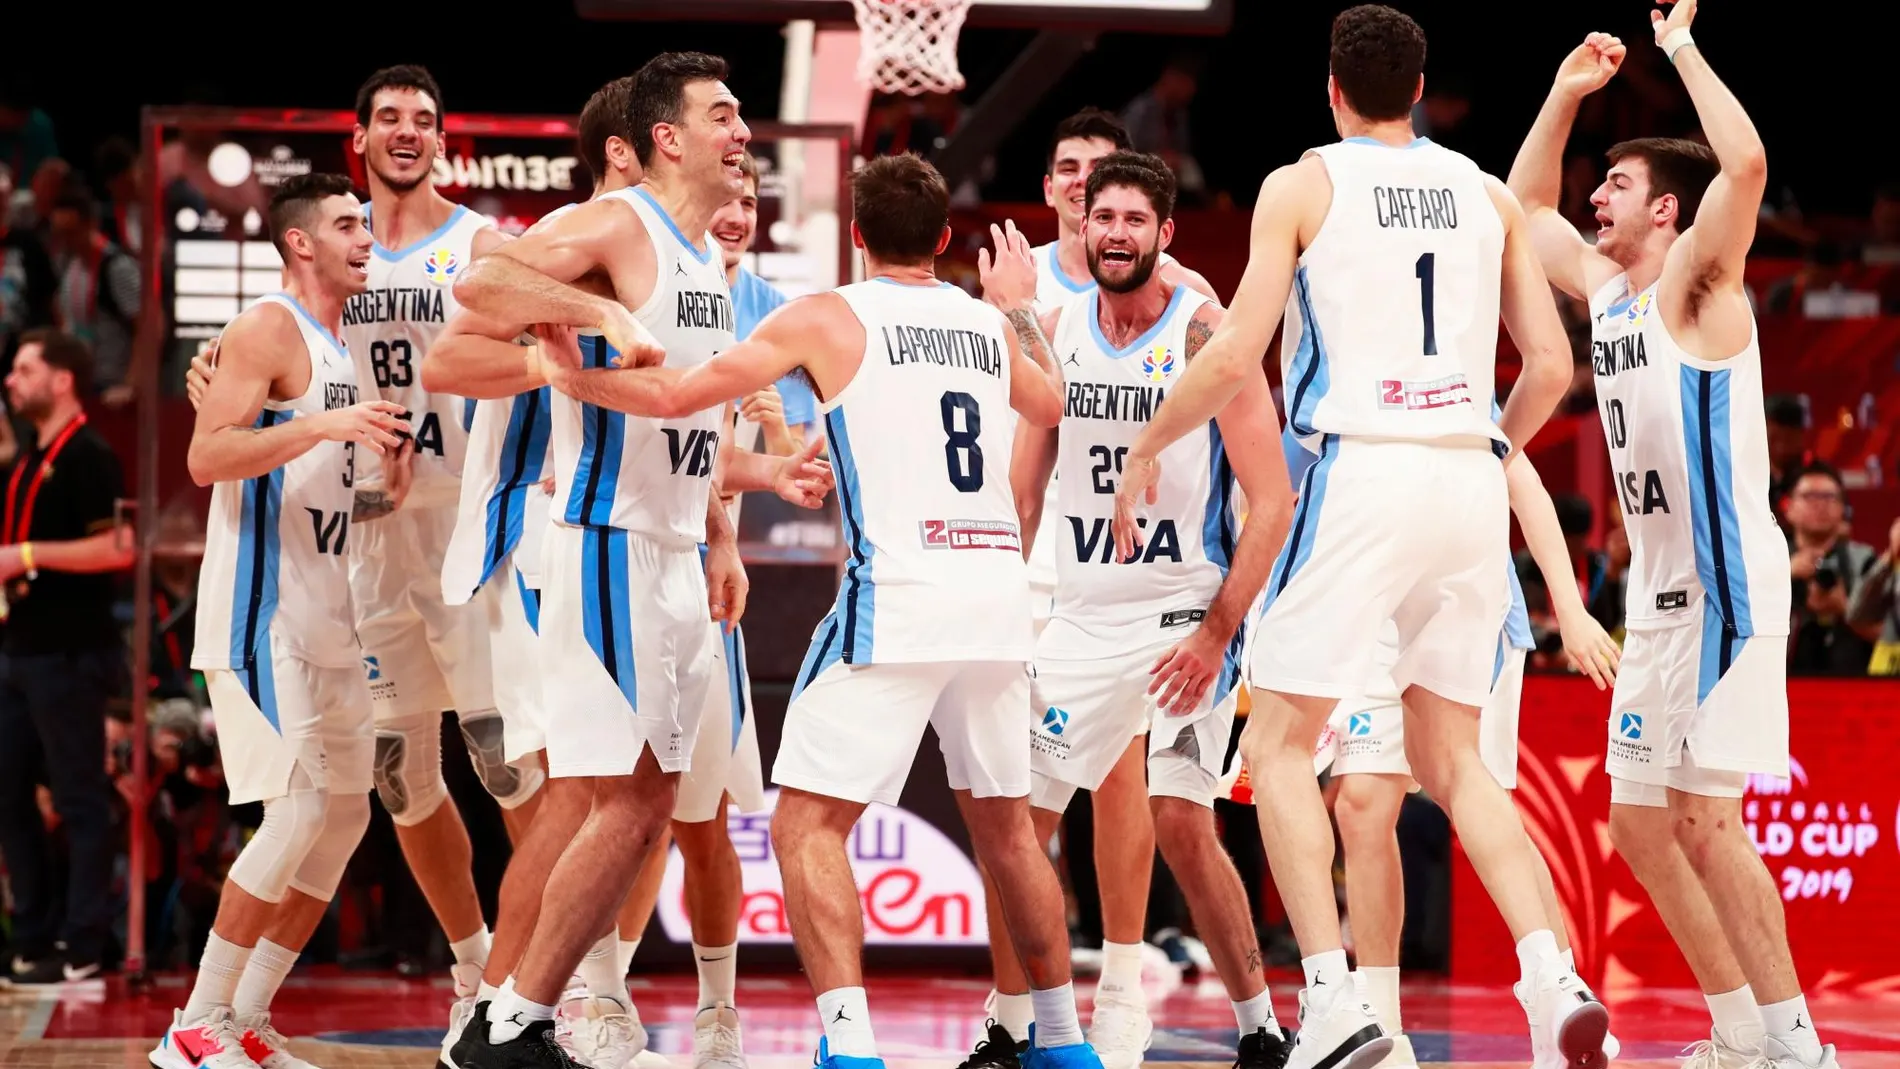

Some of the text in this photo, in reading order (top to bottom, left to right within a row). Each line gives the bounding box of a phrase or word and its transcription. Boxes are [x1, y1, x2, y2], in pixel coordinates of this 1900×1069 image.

[1373, 186, 1457, 229] CAFFARO
[342, 288, 445, 326] ARGENTINA
[677, 291, 734, 333] ARGENTIN
[1415, 252, 1438, 356] 1
[370, 339, 413, 388] 83
[882, 325, 1001, 379] LAPROVITTOLA
[1063, 382, 1165, 422] RGENTINA
[1606, 398, 1626, 449] 10
[660, 428, 720, 479] VIS
[940, 390, 983, 492] 8
[1618, 469, 1671, 515] ISA
[925, 520, 947, 543] 2
[1065, 515, 1183, 565] VISA
[1037, 734, 1071, 750] AMERICAN
[1619, 741, 1652, 752] AMERICAN
[1800, 822, 1879, 858] CUP
[1781, 865, 1854, 904] 2019
